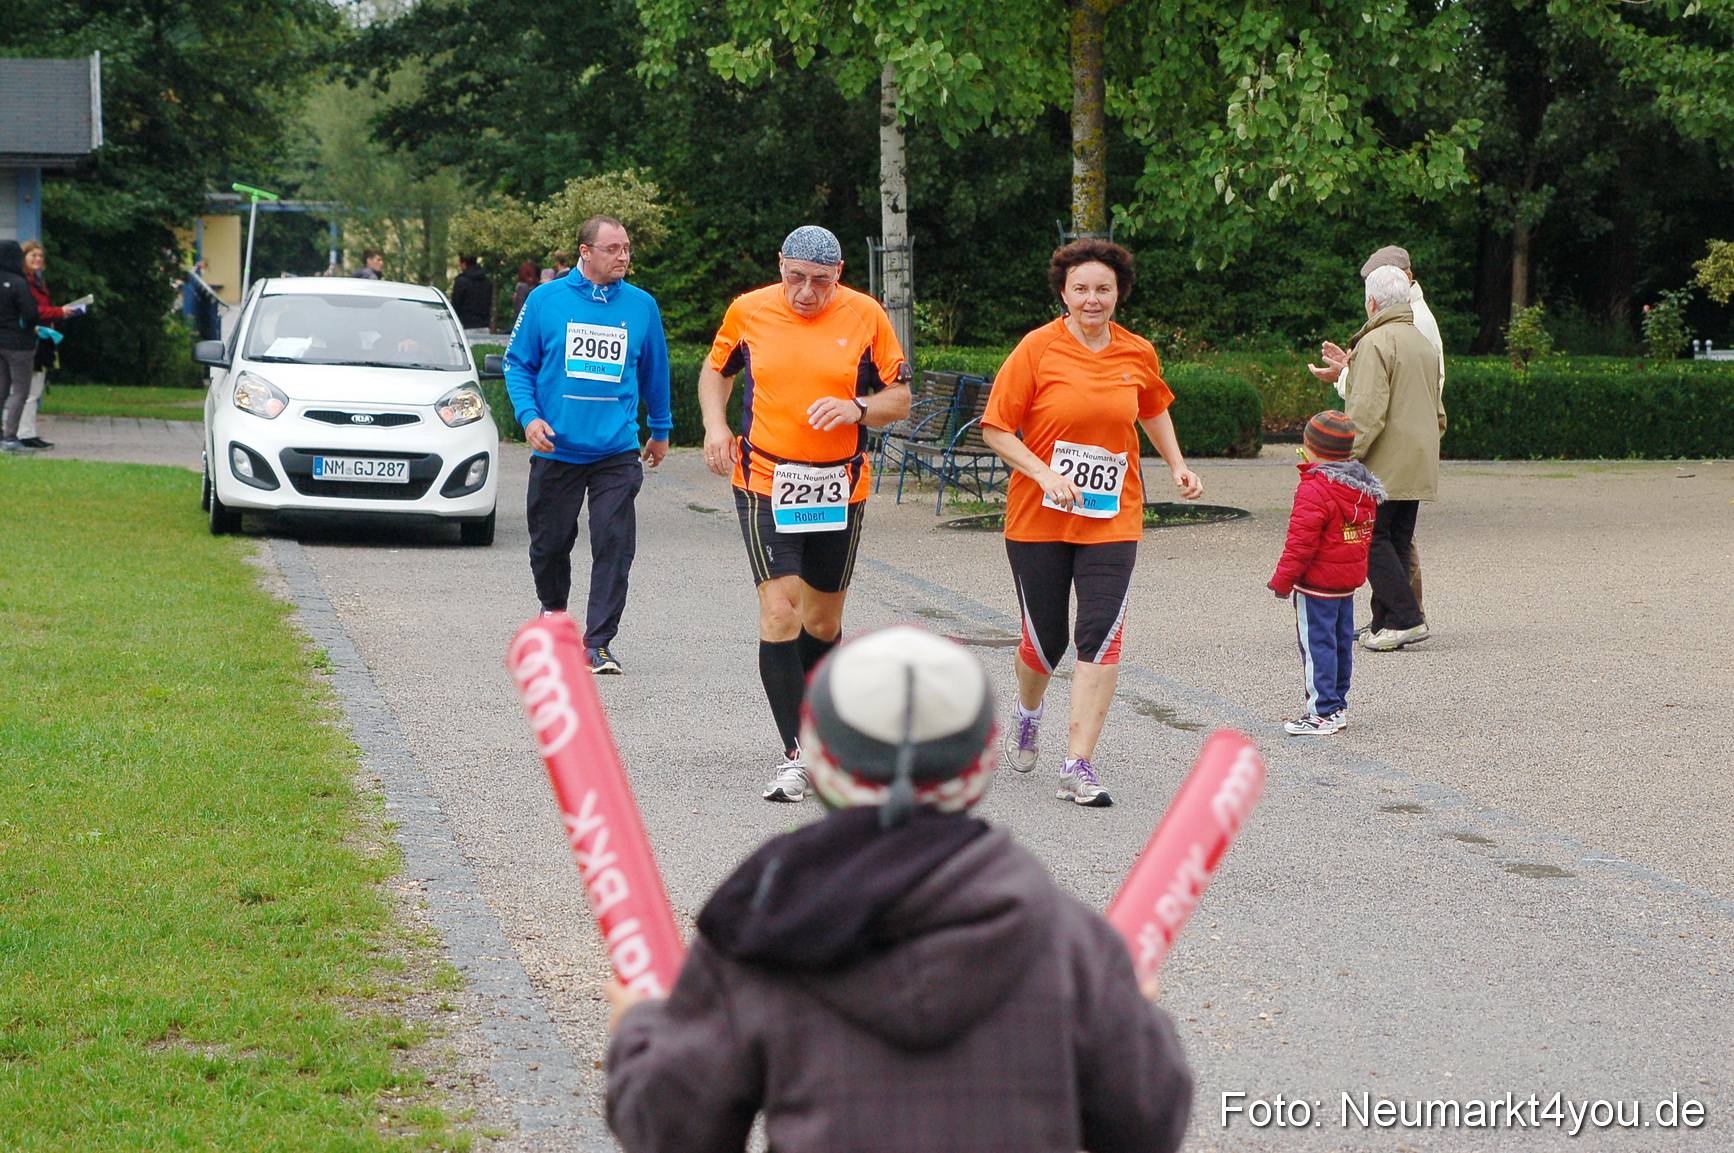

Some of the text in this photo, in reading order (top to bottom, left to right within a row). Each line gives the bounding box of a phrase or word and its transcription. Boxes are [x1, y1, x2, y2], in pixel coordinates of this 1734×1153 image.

[589, 330, 618, 338] Neumarkt
[572, 337, 621, 361] 2969
[584, 362, 606, 373] Frank
[354, 414, 371, 423] KIA
[1055, 447, 1117, 463] PARTL Neumarkt
[324, 460, 345, 475] NM
[354, 461, 374, 476] GJ
[377, 462, 405, 477] 287
[1059, 458, 1118, 491] 2863
[776, 471, 837, 481] PARTL Neumarkt
[780, 481, 842, 505] 2213
[794, 510, 826, 521] Robert
